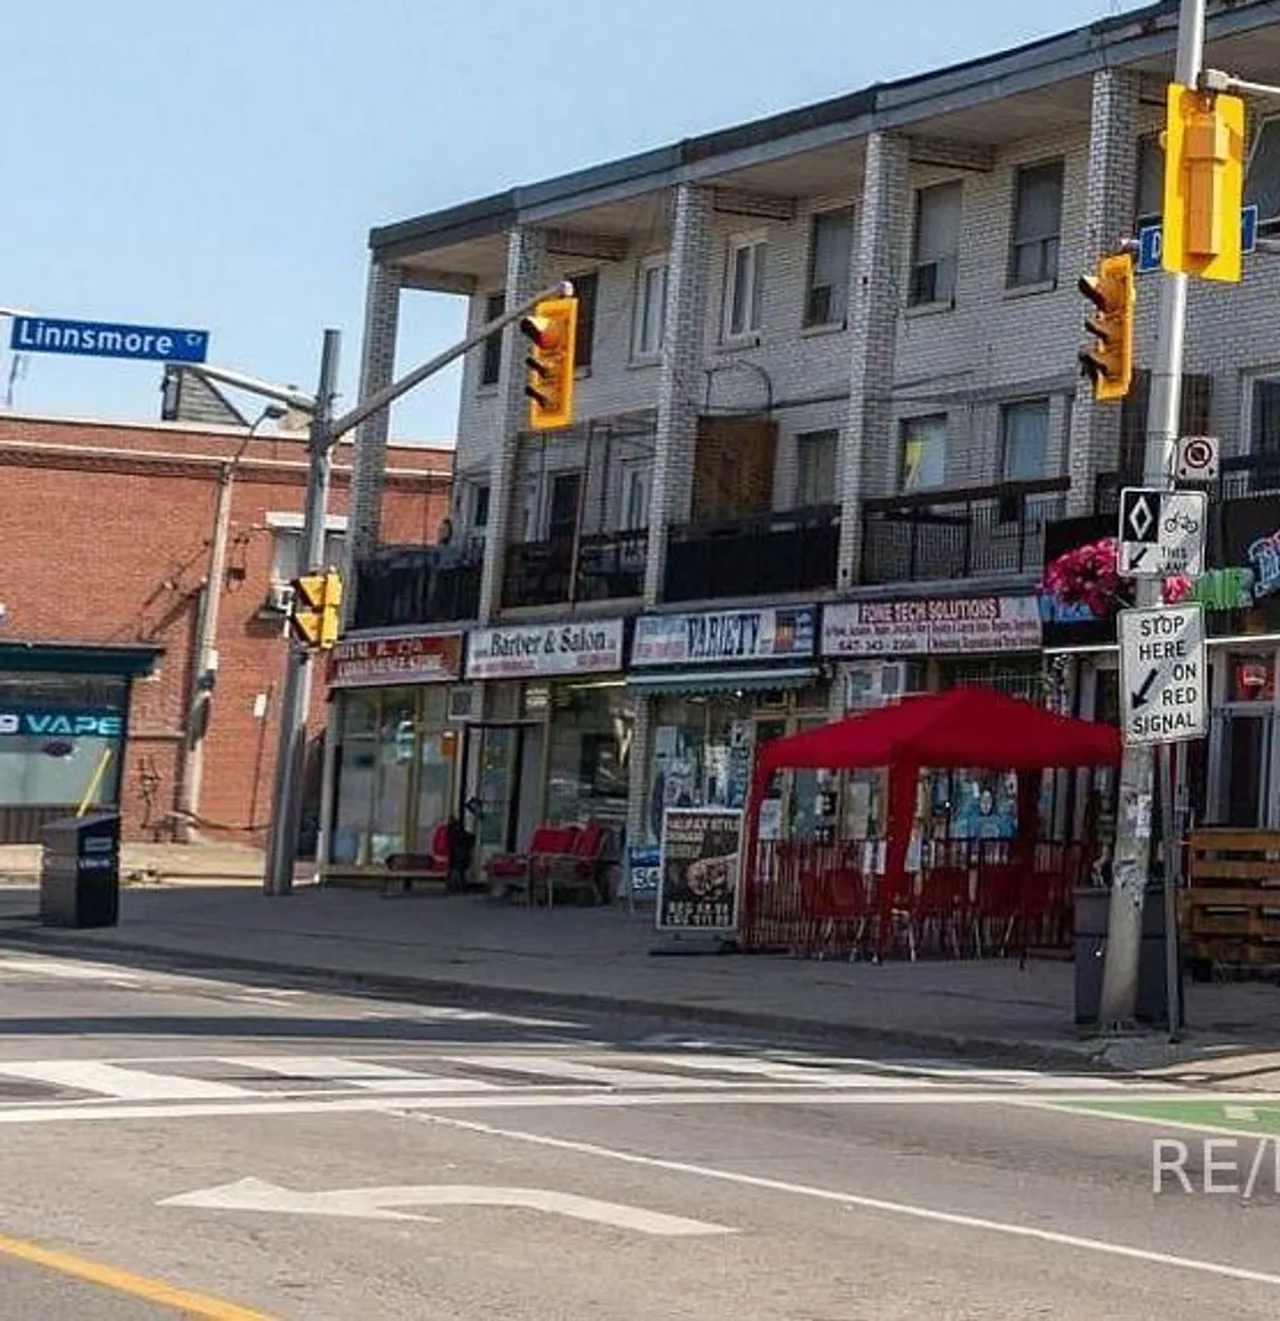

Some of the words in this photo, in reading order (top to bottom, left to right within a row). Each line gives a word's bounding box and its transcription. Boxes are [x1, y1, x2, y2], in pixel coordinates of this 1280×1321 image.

[20, 320, 173, 354] Linnsmore
[687, 614, 761, 657] VARIETY
[1140, 616, 1185, 637] STOP
[491, 633, 541, 657] Barber
[560, 627, 606, 654] Salon
[1138, 642, 1188, 661] HERE
[1173, 663, 1197, 681] ON
[1161, 687, 1198, 707] RED
[25, 714, 123, 735] VAPE
[1132, 713, 1197, 735] SIGNAL
